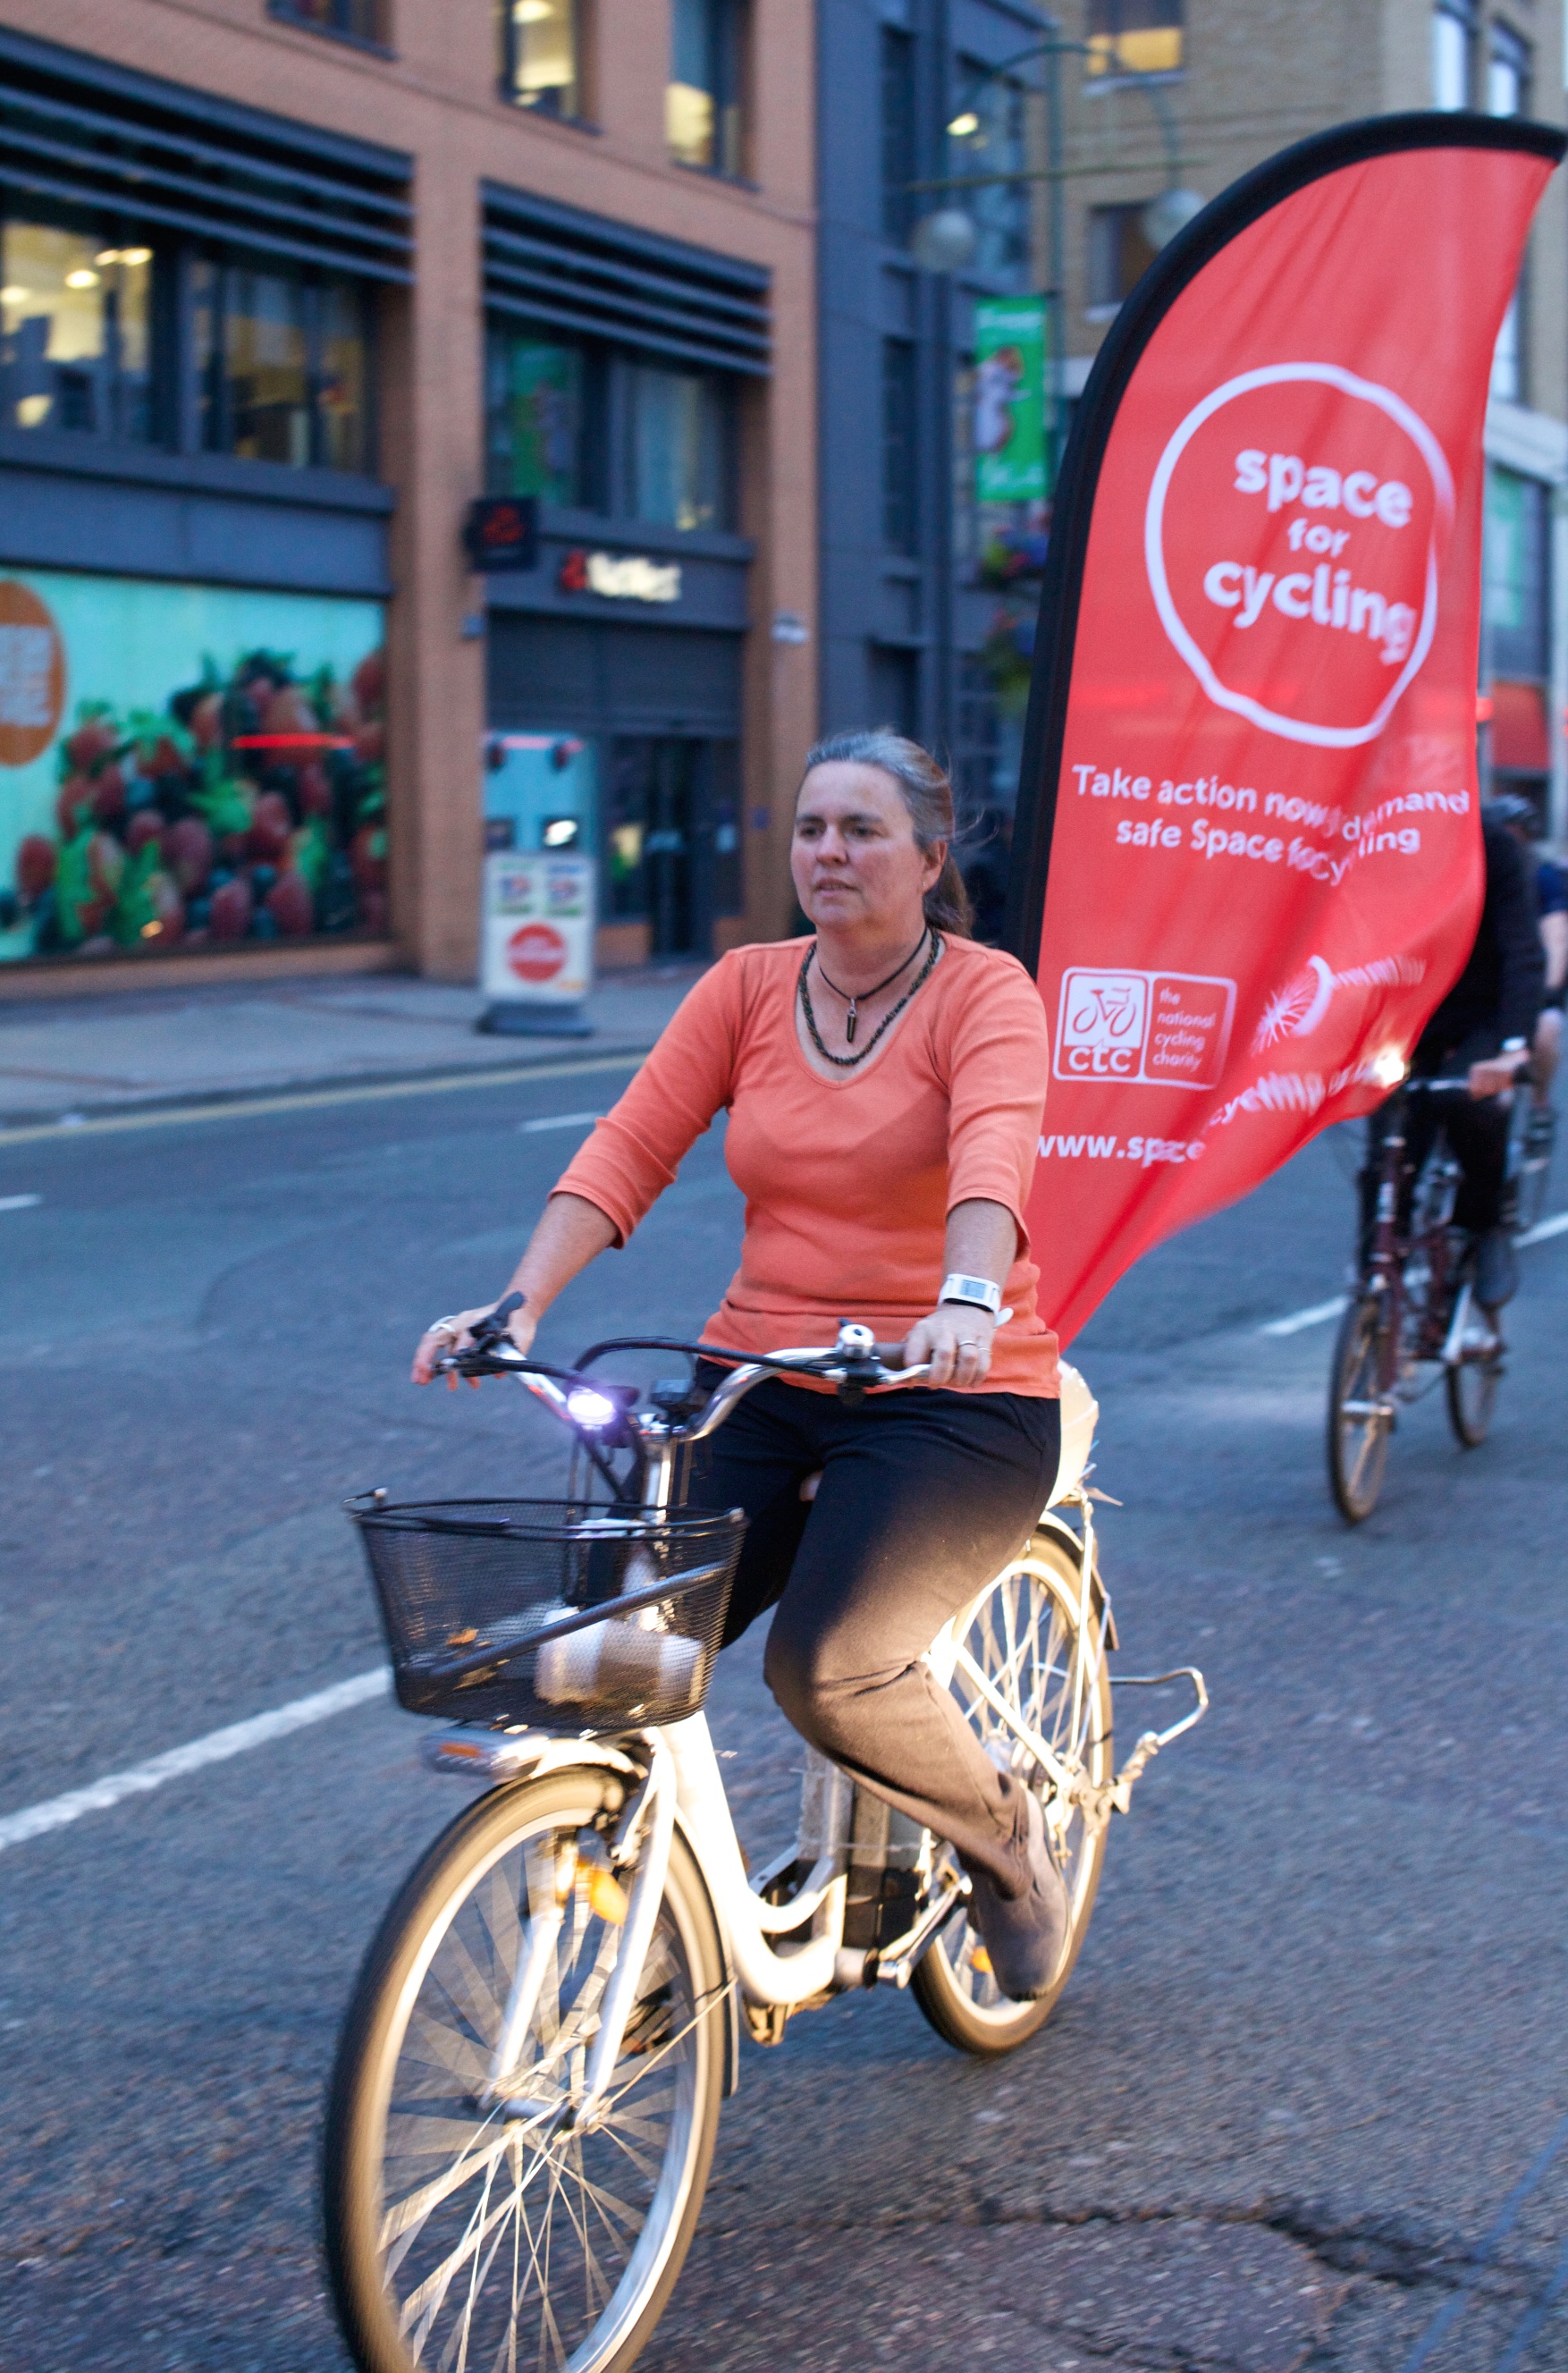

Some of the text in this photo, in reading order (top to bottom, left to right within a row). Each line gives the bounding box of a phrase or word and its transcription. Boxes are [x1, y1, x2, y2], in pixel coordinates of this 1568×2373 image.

[1234, 449, 1413, 528] space
[1287, 518, 1351, 558] for
[1203, 561, 1417, 666] cycling
[1072, 764, 1152, 801] Take
[1157, 774, 1257, 813] action
[1264, 792, 1328, 829] now
[1116, 817, 1183, 848] safe
[1190, 818, 1285, 859] Space
[1159, 986, 1181, 1005] the
[1157, 1011, 1218, 1029] national
[1068, 1038, 1133, 1073] ctc
[1154, 1029, 1206, 1052] cycling
[1152, 1050, 1202, 1073] charity
